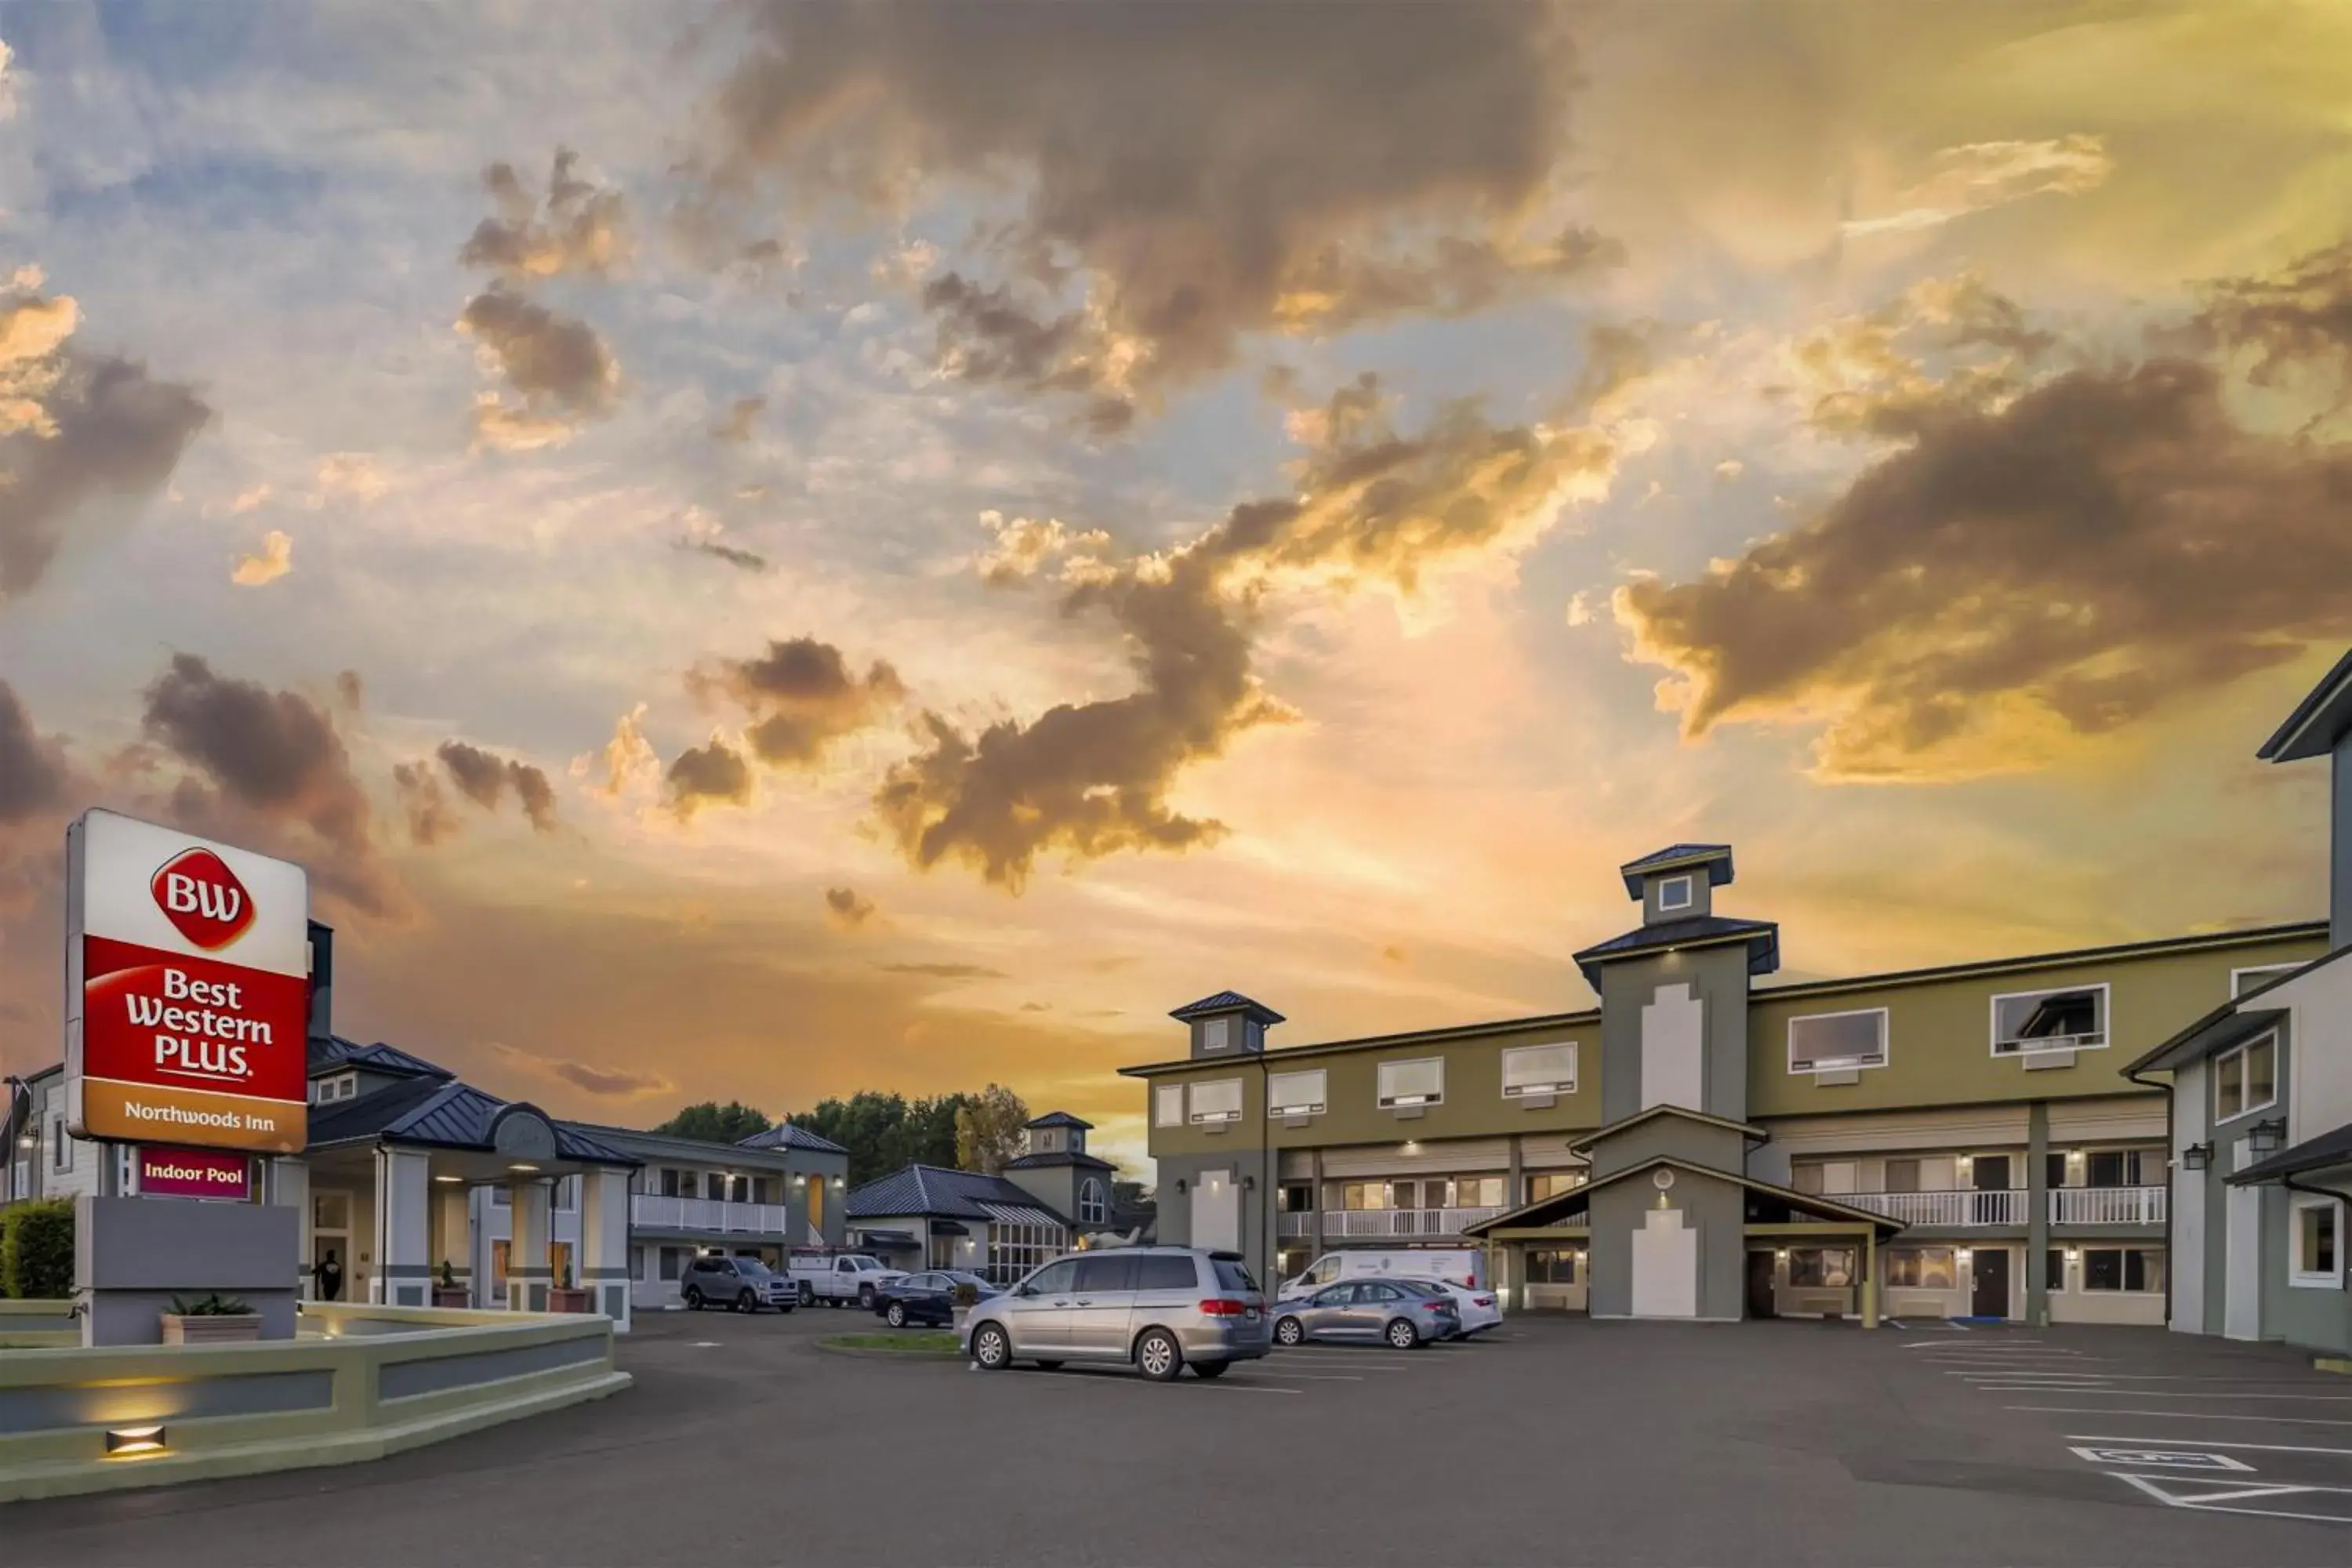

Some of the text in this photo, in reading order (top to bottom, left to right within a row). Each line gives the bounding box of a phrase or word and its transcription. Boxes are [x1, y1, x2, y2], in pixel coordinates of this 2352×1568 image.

[167, 873, 241, 922] BW
[164, 968, 242, 1010] Best
[125, 993, 274, 1045] Western
[125, 1101, 275, 1131] Northwoods Inn
[145, 1163, 243, 1184] Indoor Pool
